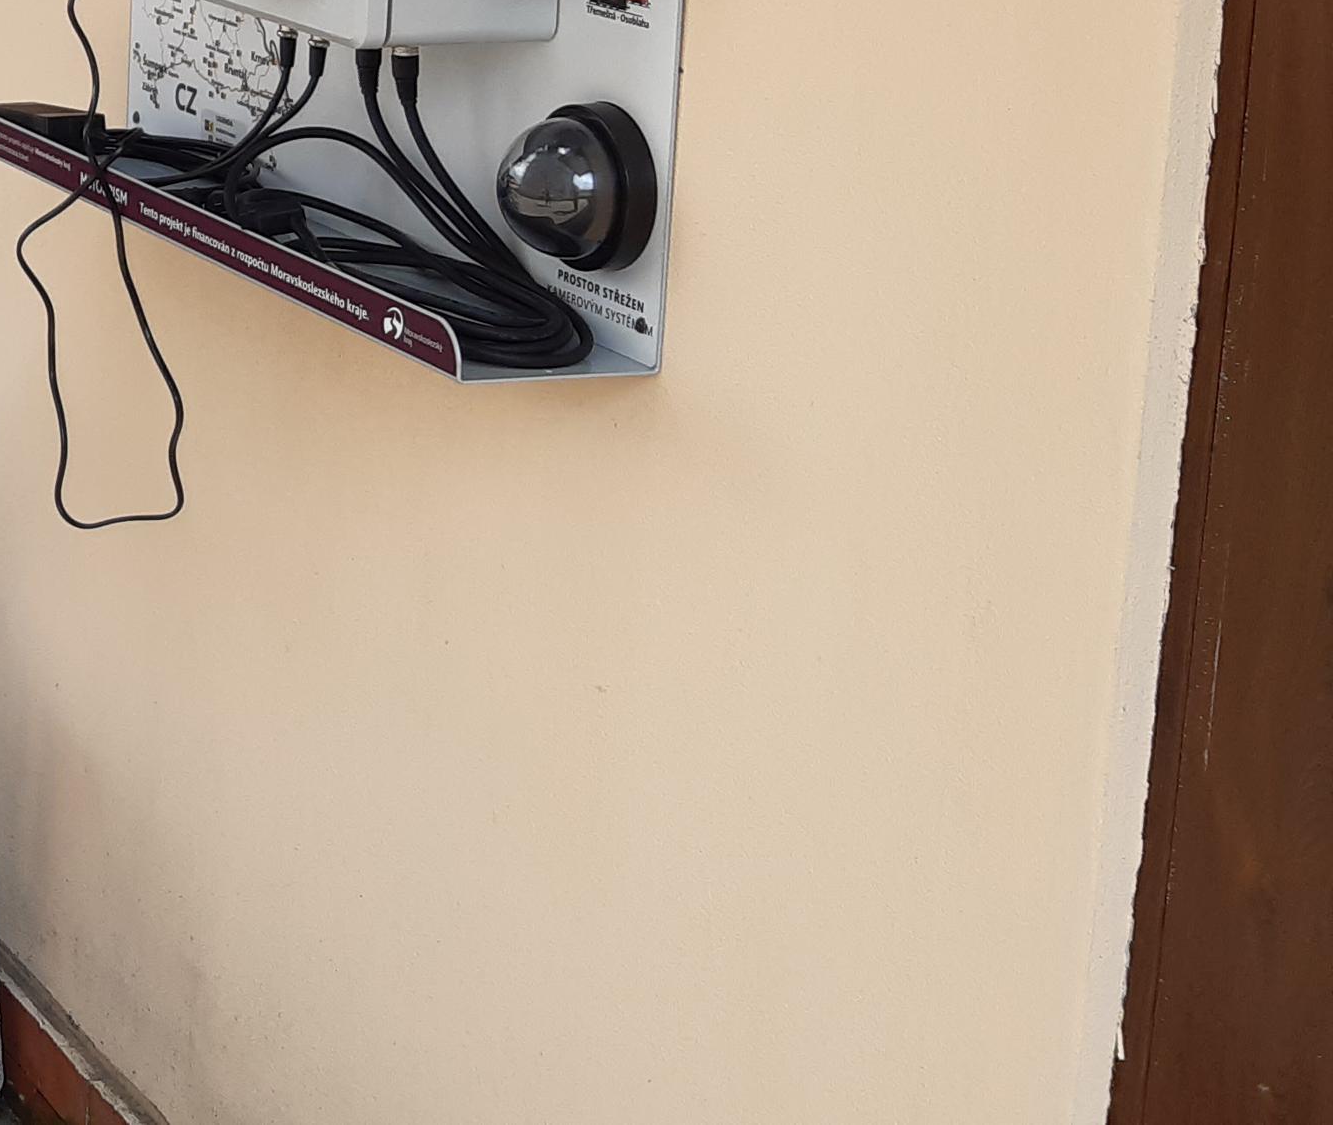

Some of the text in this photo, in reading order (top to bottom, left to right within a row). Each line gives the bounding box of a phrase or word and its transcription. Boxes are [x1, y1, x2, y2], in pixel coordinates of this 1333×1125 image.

[175, 82, 198, 116] CZ
[139, 201, 370, 321] Tento projekt je financován z rozpočtu Moravskoslezského kraje.
[547, 283, 603, 316] KAMEROVÝM
[557, 268, 645, 314] PROSTOR STŘEŽEN
